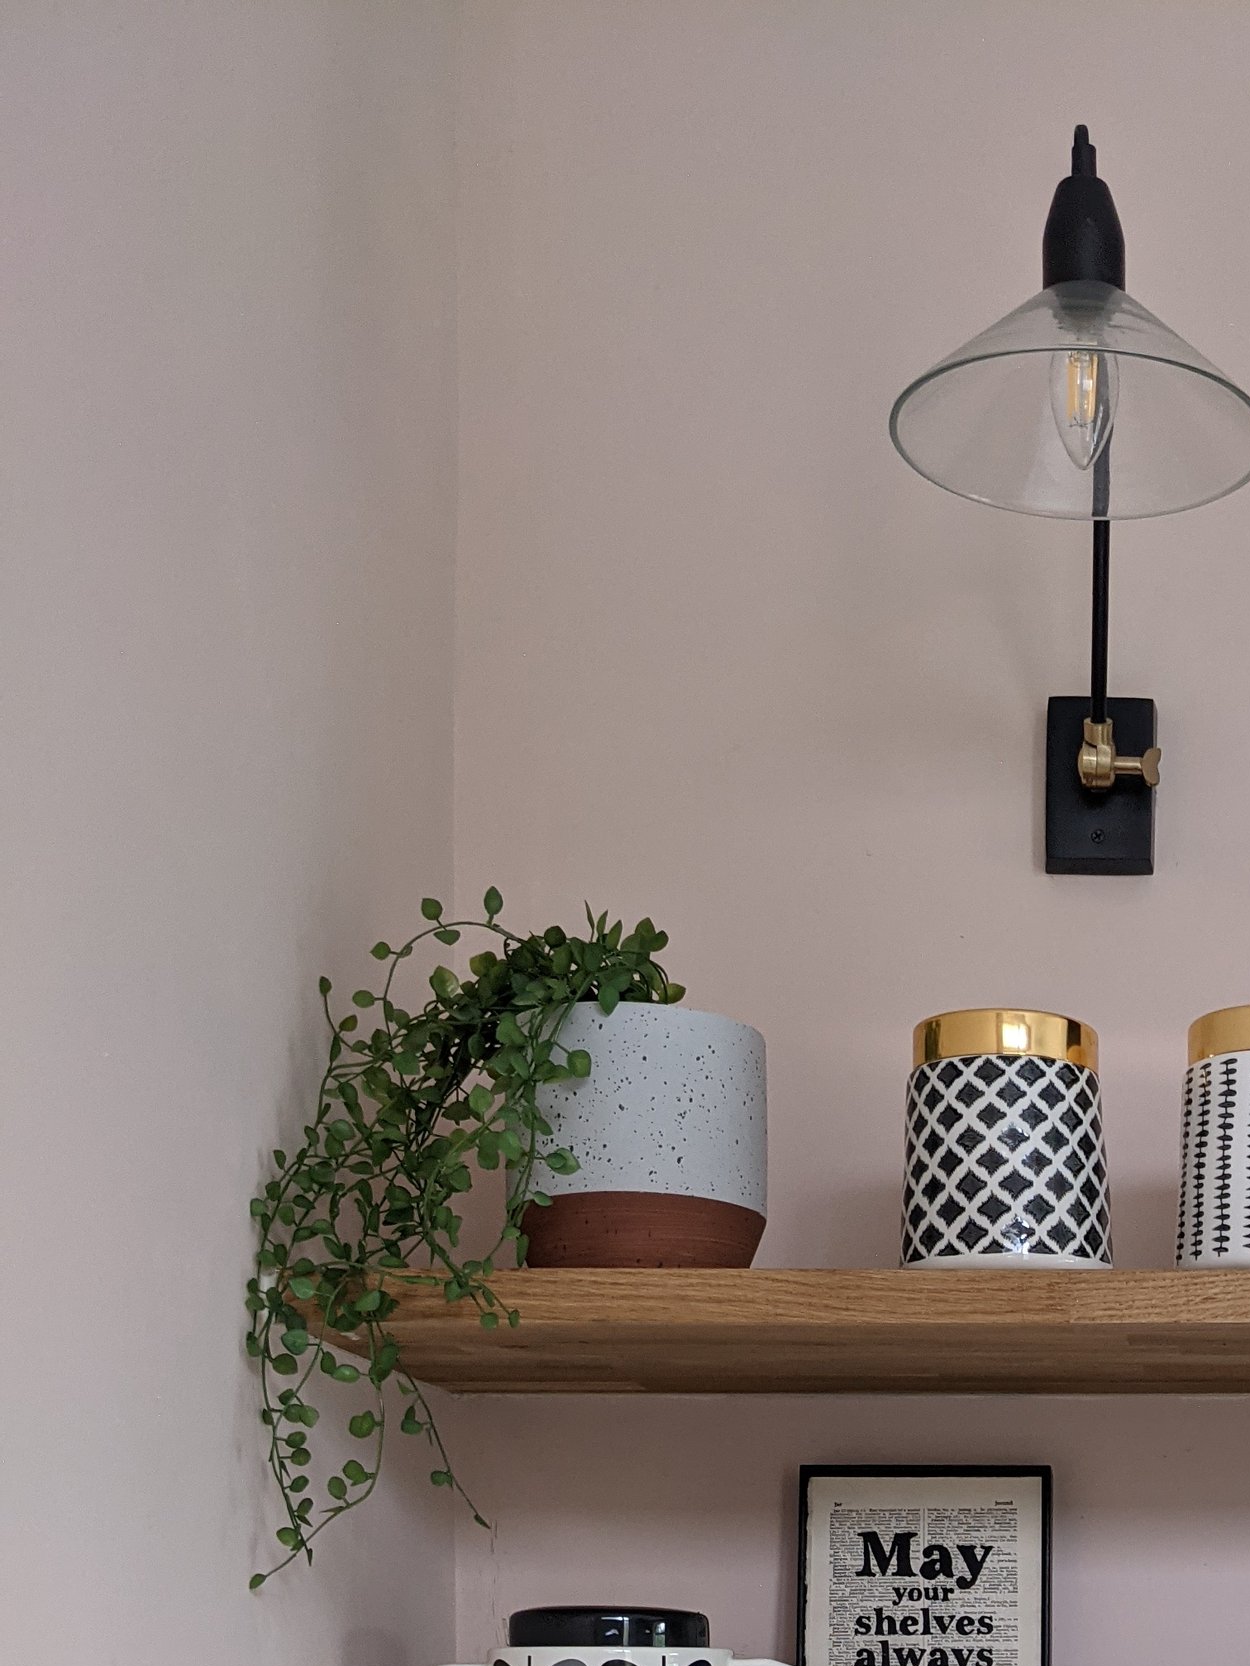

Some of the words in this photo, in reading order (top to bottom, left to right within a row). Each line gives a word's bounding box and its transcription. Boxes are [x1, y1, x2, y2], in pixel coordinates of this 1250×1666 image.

[854, 1530, 995, 1590] May
[891, 1585, 955, 1606] your
[854, 1607, 994, 1636] shelves
